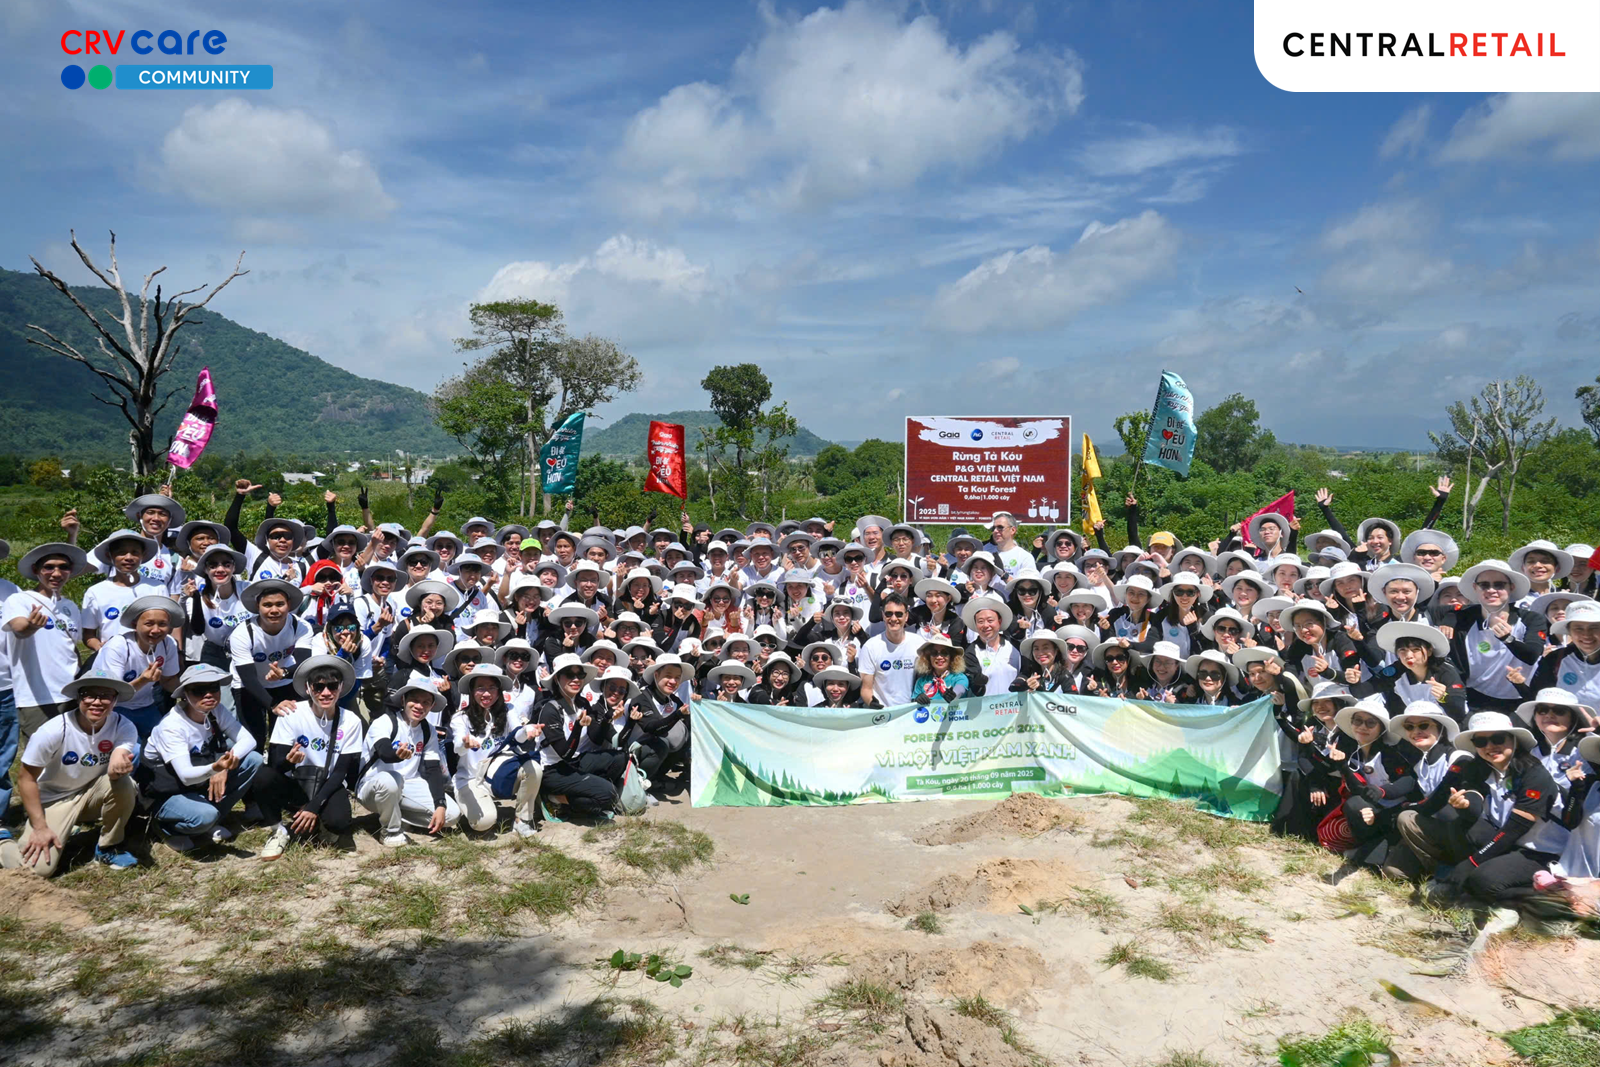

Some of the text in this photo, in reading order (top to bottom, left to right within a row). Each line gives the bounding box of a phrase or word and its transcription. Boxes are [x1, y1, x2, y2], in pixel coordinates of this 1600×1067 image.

[977, 464, 996, 474] VIỆT
[1002, 474, 1020, 484] VIỆT
[990, 700, 1024, 710] CENTRAL
[1046, 701, 1077, 714] Gaia
[904, 724, 1046, 744] FORESTS FOR GOOD 2025
[876, 742, 1077, 770] VÌ MỘT VIỆT NAM XANH
[942, 776, 960, 786] ngày
[970, 774, 989, 782] tháng
[992, 782, 1004, 790] cây
